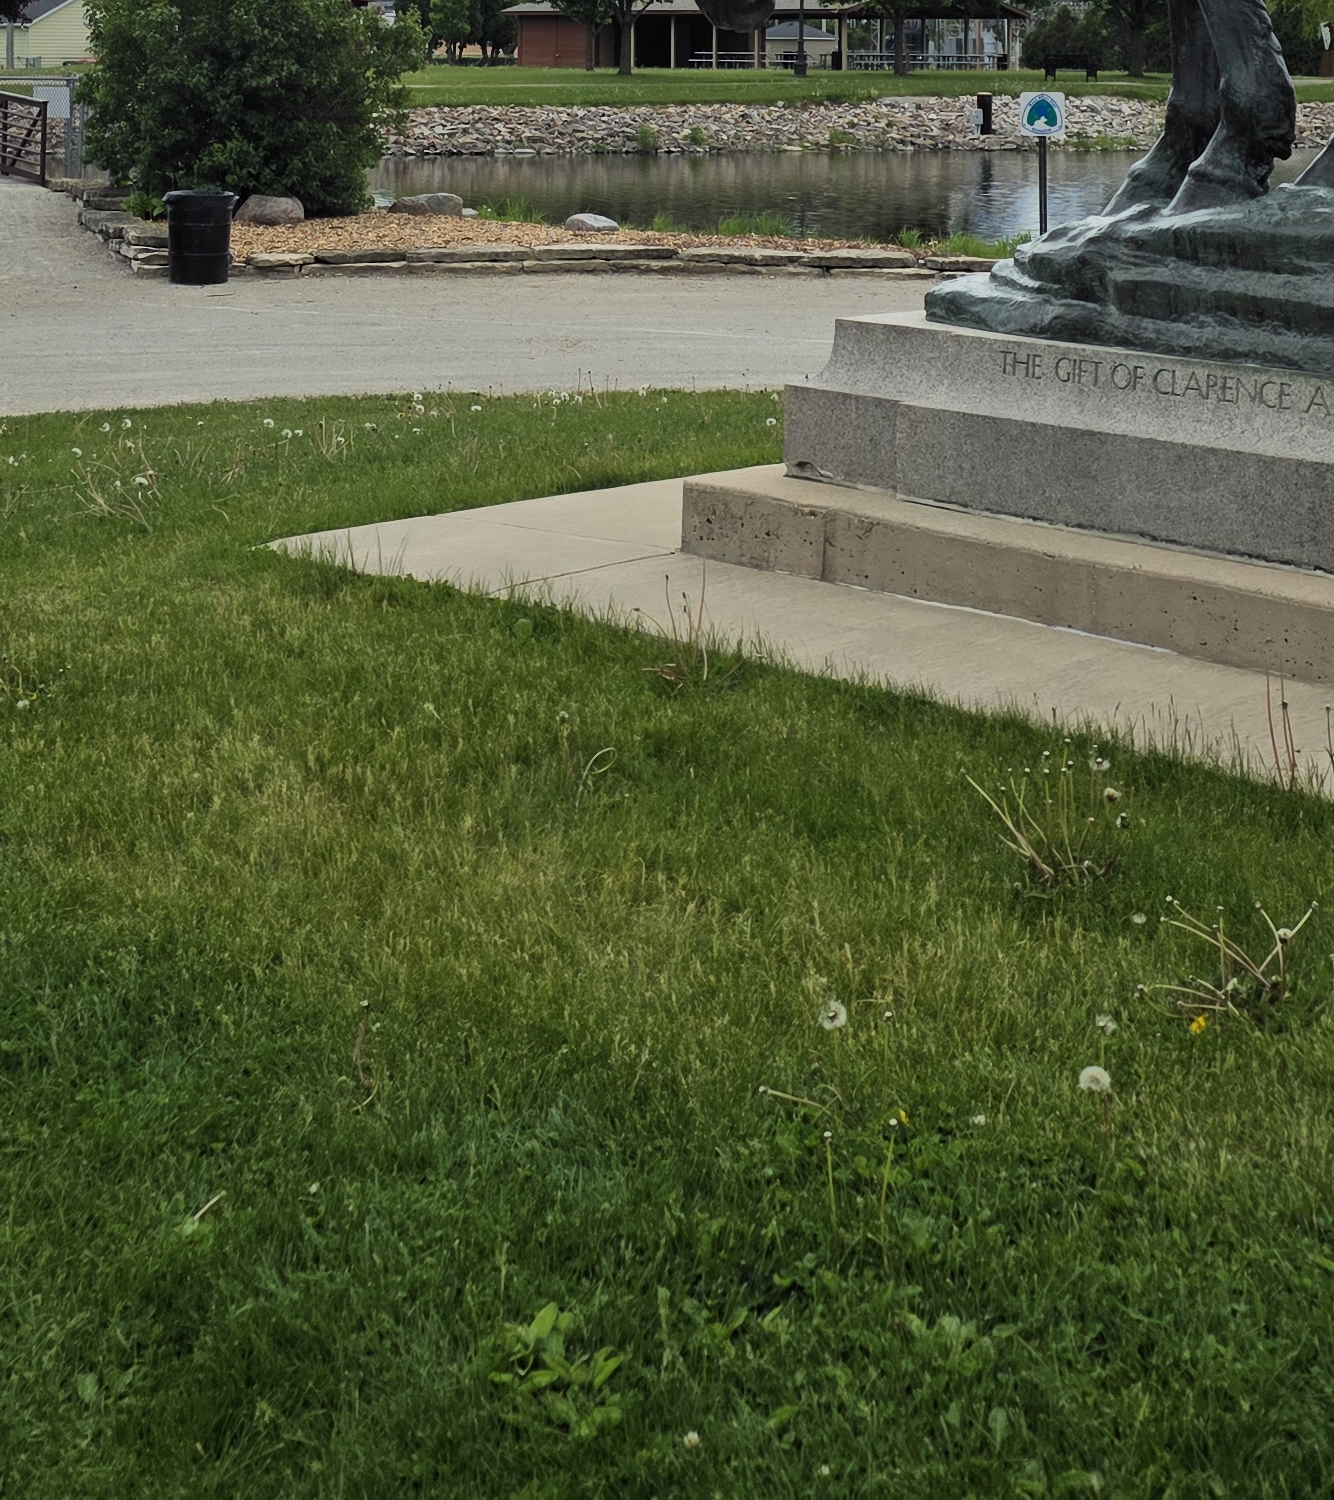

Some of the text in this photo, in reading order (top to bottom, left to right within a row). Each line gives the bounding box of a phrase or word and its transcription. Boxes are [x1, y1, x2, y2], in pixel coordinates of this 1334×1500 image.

[999, 350, 1043, 380] THE
[1054, 356, 1104, 387] GIFT
[1111, 363, 1145, 391] OF
[1153, 368, 1293, 411] CLARENCE
